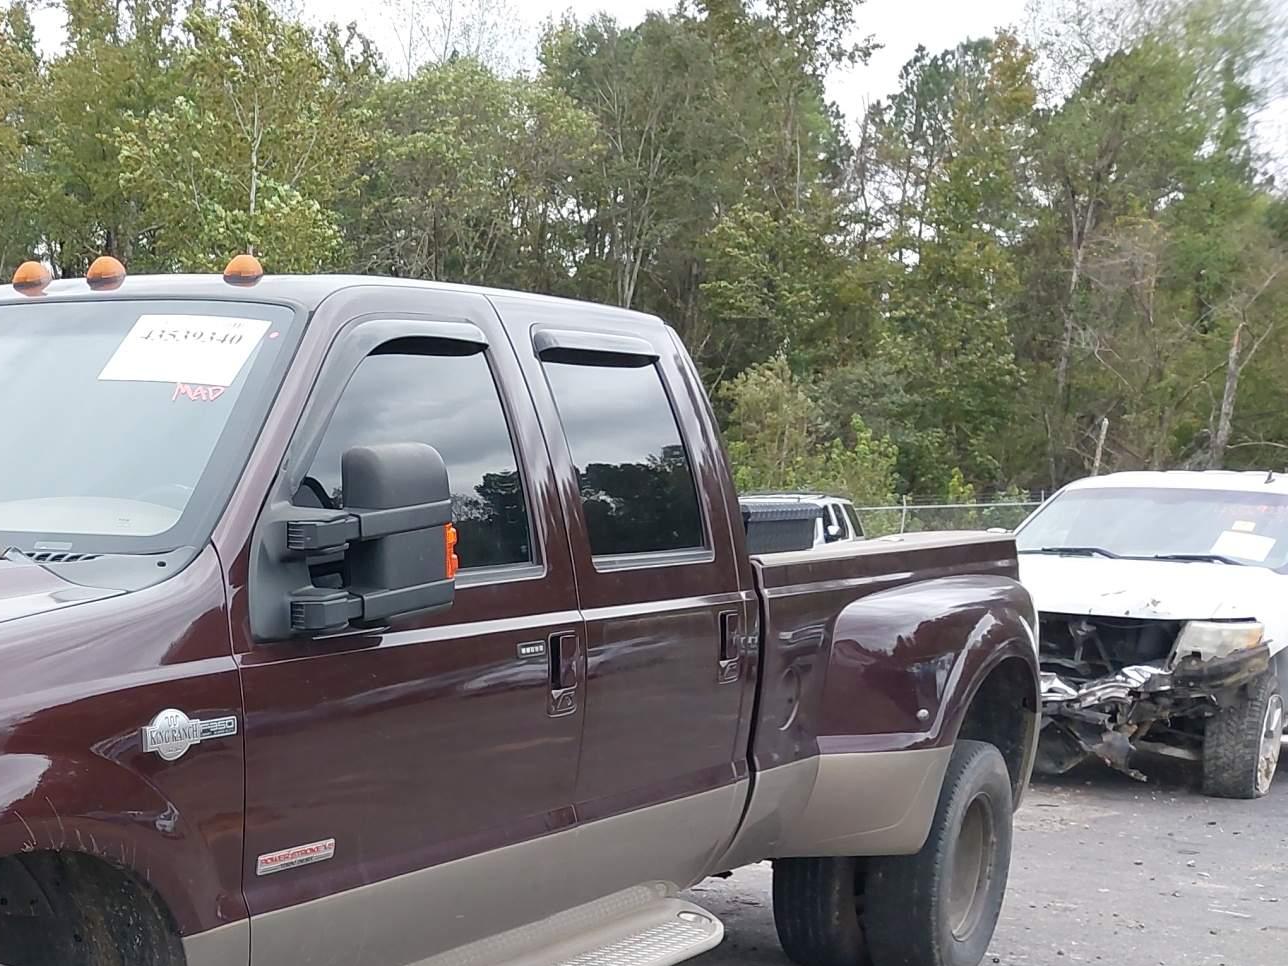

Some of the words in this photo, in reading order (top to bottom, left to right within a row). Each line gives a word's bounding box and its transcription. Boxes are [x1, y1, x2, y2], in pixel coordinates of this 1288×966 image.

[139, 328, 244, 345] 43539340
[150, 728, 171, 746] KING
[171, 723, 199, 743] RANCH
